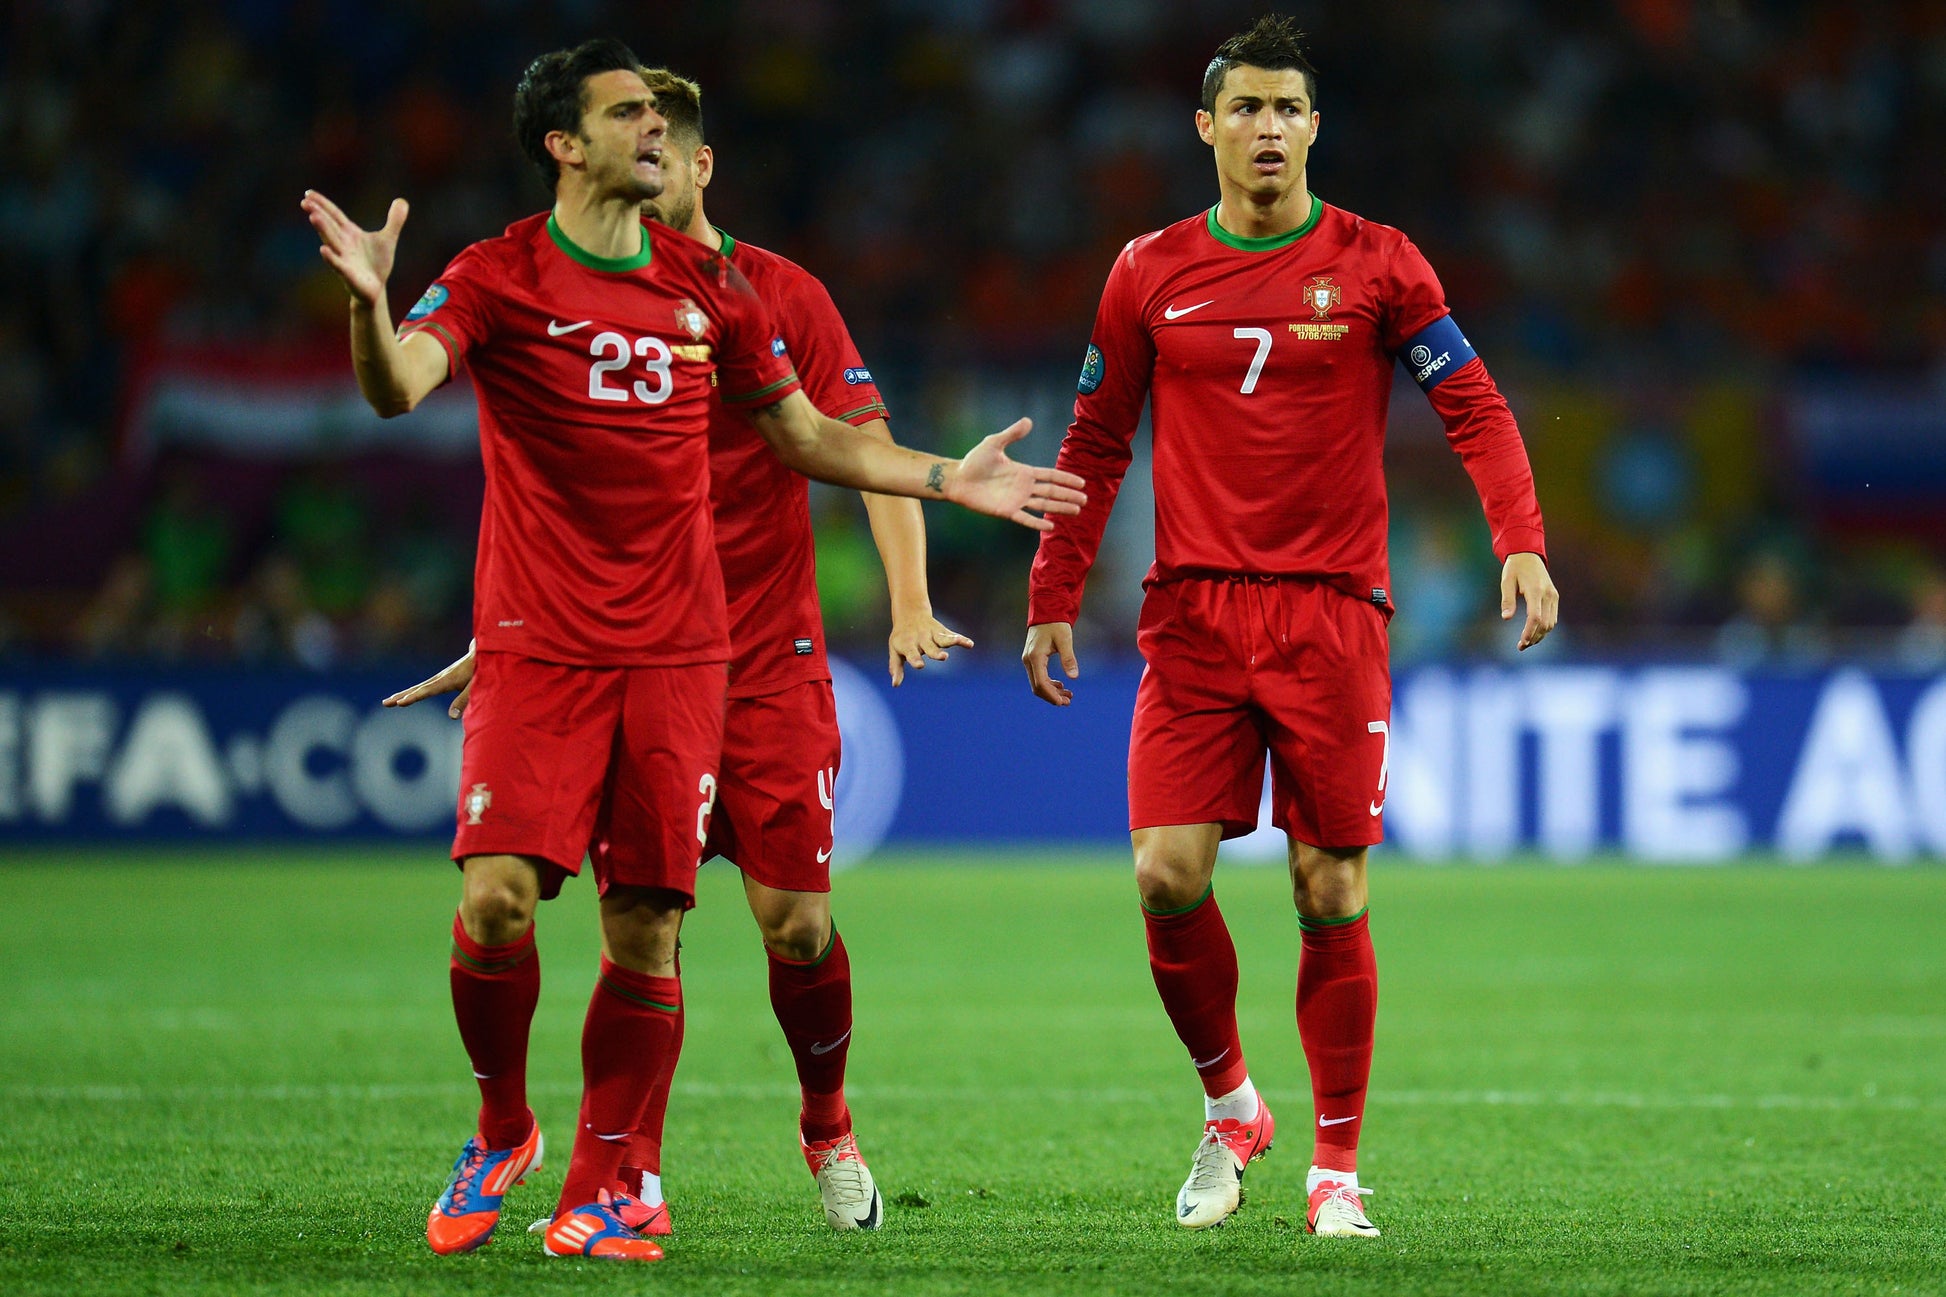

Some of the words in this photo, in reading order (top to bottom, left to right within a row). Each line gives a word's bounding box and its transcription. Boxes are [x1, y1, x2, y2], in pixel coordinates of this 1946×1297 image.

[588, 331, 674, 405] 23
[1233, 327, 1273, 394] 7
[1297, 332, 1342, 341] 17/06/2012
[1415, 351, 1451, 383] ESPECT
[1367, 720, 1390, 791] 7
[1384, 668, 1748, 860] NITE
